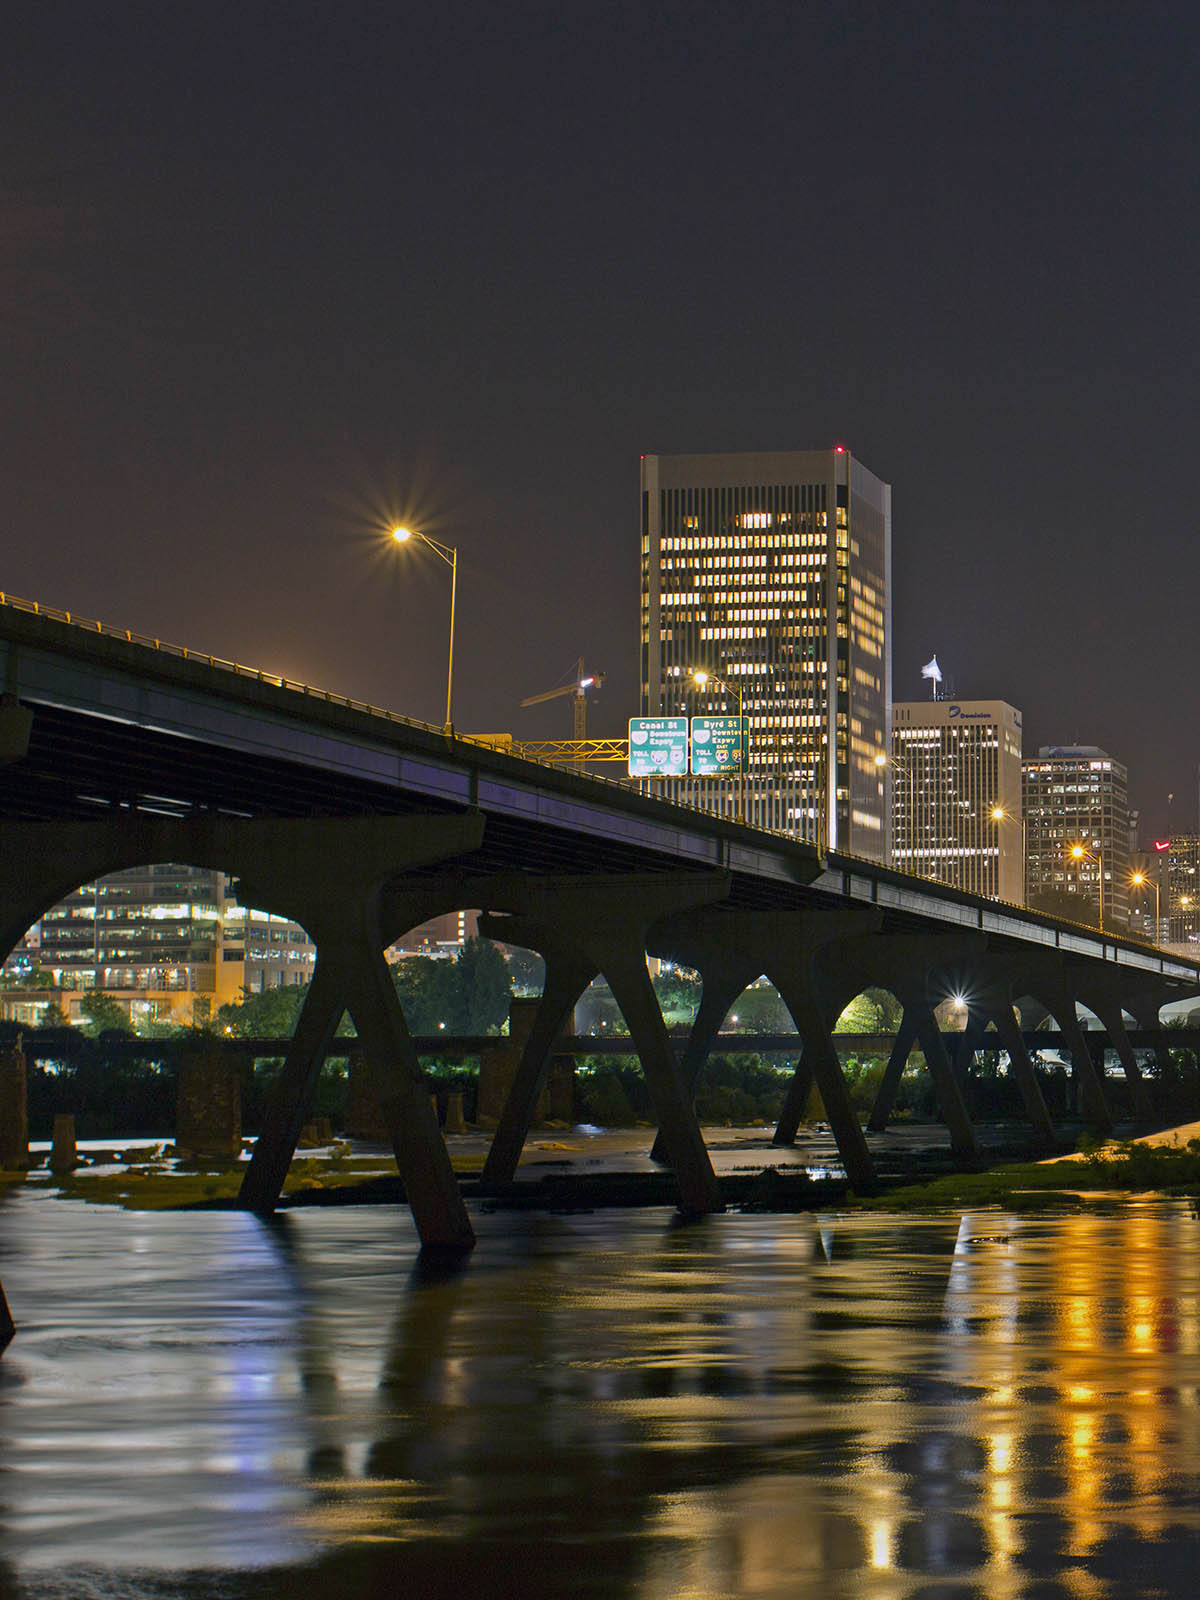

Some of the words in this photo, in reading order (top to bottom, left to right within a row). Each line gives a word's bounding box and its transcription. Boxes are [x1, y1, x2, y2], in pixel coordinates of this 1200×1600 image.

[639, 721, 664, 729] Canal
[668, 721, 677, 729] St
[704, 720, 724, 729] Byrd
[728, 720, 737, 728] St
[712, 737, 736, 745] Expwy
